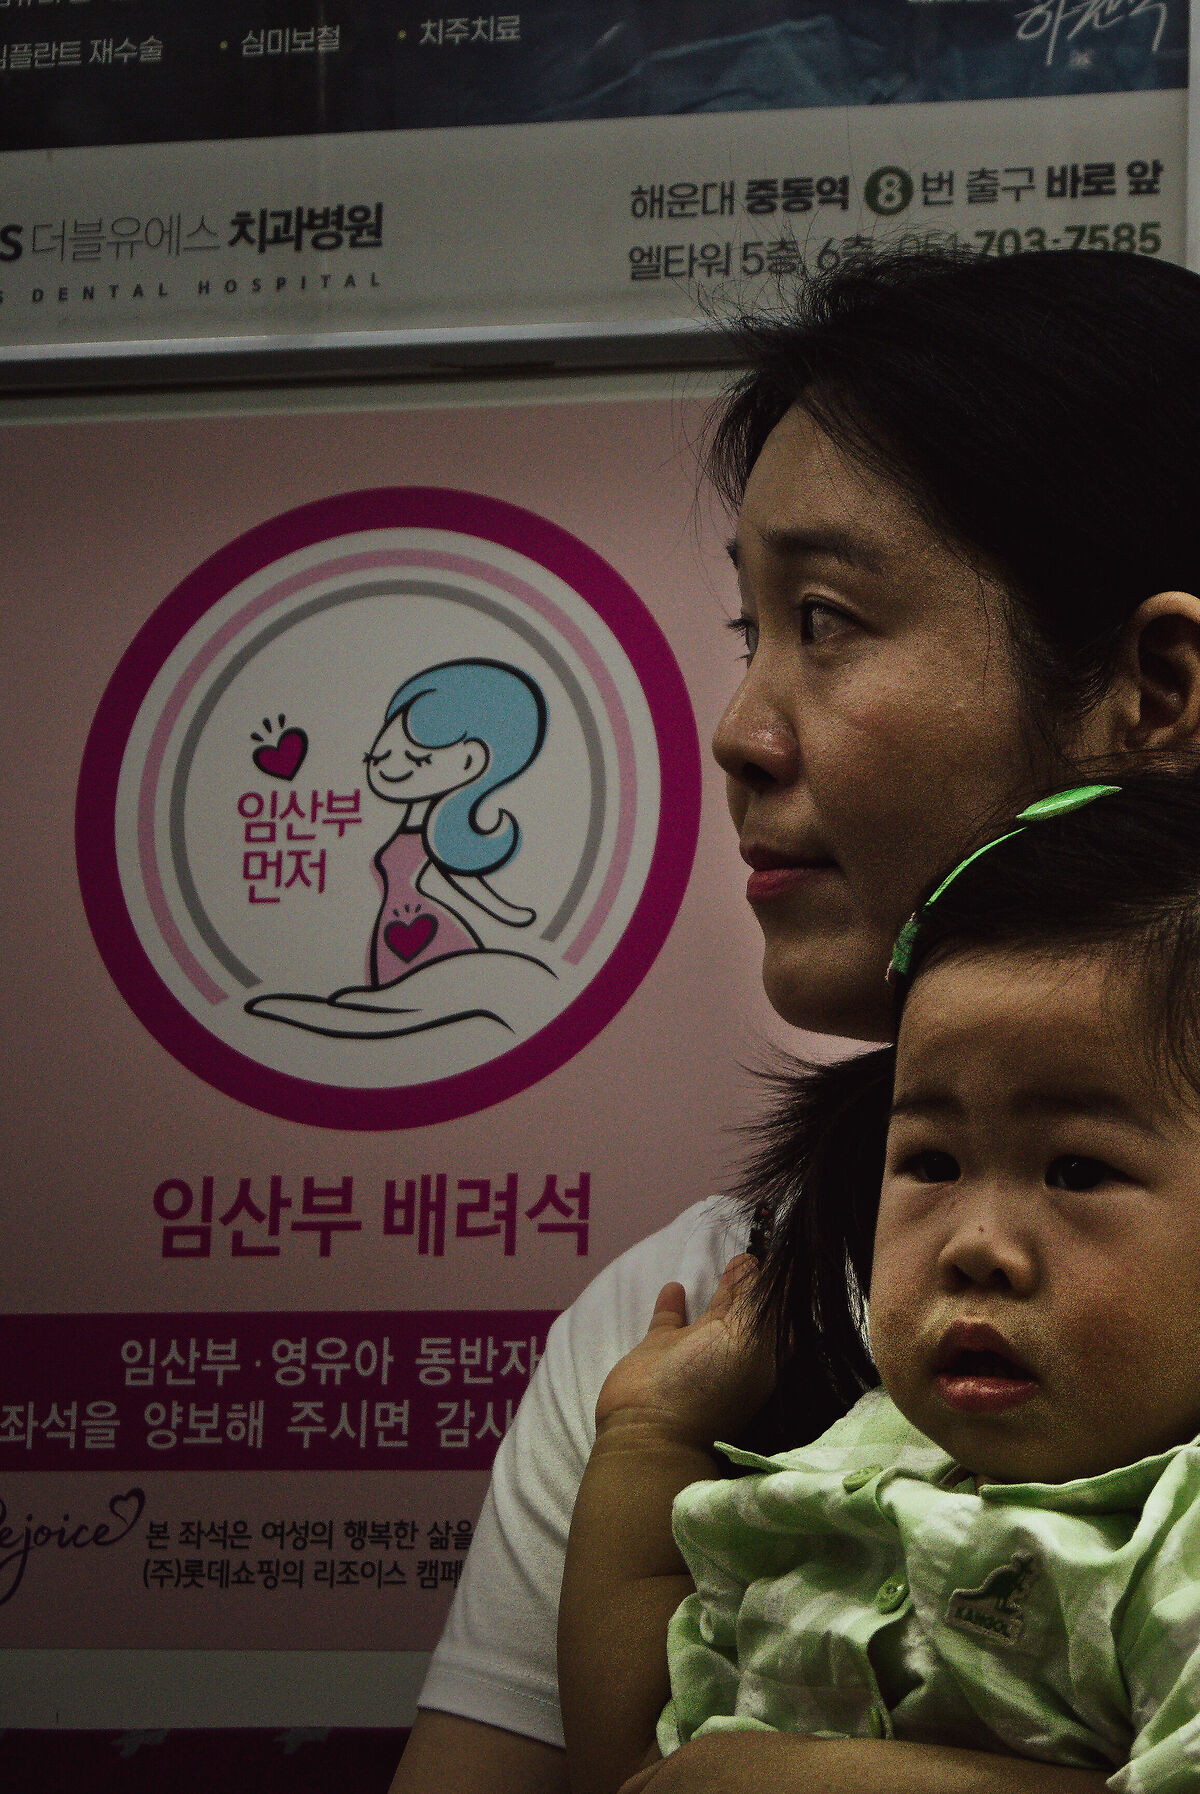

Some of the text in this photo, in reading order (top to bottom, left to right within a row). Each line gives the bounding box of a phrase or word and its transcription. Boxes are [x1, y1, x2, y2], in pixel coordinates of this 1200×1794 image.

[240, 24, 341, 57] 심미보철
[419, 14, 521, 46] 치주치료
[88, 35, 164, 64] 재수술
[629, 181, 736, 219] 해운대
[746, 176, 850, 215] 중동역
[965, 168, 1036, 204] 출구
[1045, 164, 1117, 200] 바로
[1126, 160, 1163, 197] 앞
[32, 201, 384, 262] 더블유에스 치과병원
[629, 243, 732, 281] 엘타워
[32, 272, 381, 304] DENTAL HOSPITAL
[237, 789, 363, 843] 임산부
[243, 850, 327, 904] 먼저
[152, 1172, 592, 1259] 임산부 배려석
[0, 1401, 121, 1450] 좌석을
[143, 1400, 264, 1450] 양보해
[286, 1400, 411, 1449] 주시면
[145, 1521, 171, 1550] 본
[179, 1521, 254, 1550] 좌석은
[261, 1521, 335, 1550] 여성의
[344, 1521, 420, 1550] 행복한
[143, 1558, 305, 1588] (주)롯데쇼핑의
[314, 1558, 406, 1588] 리조이스
